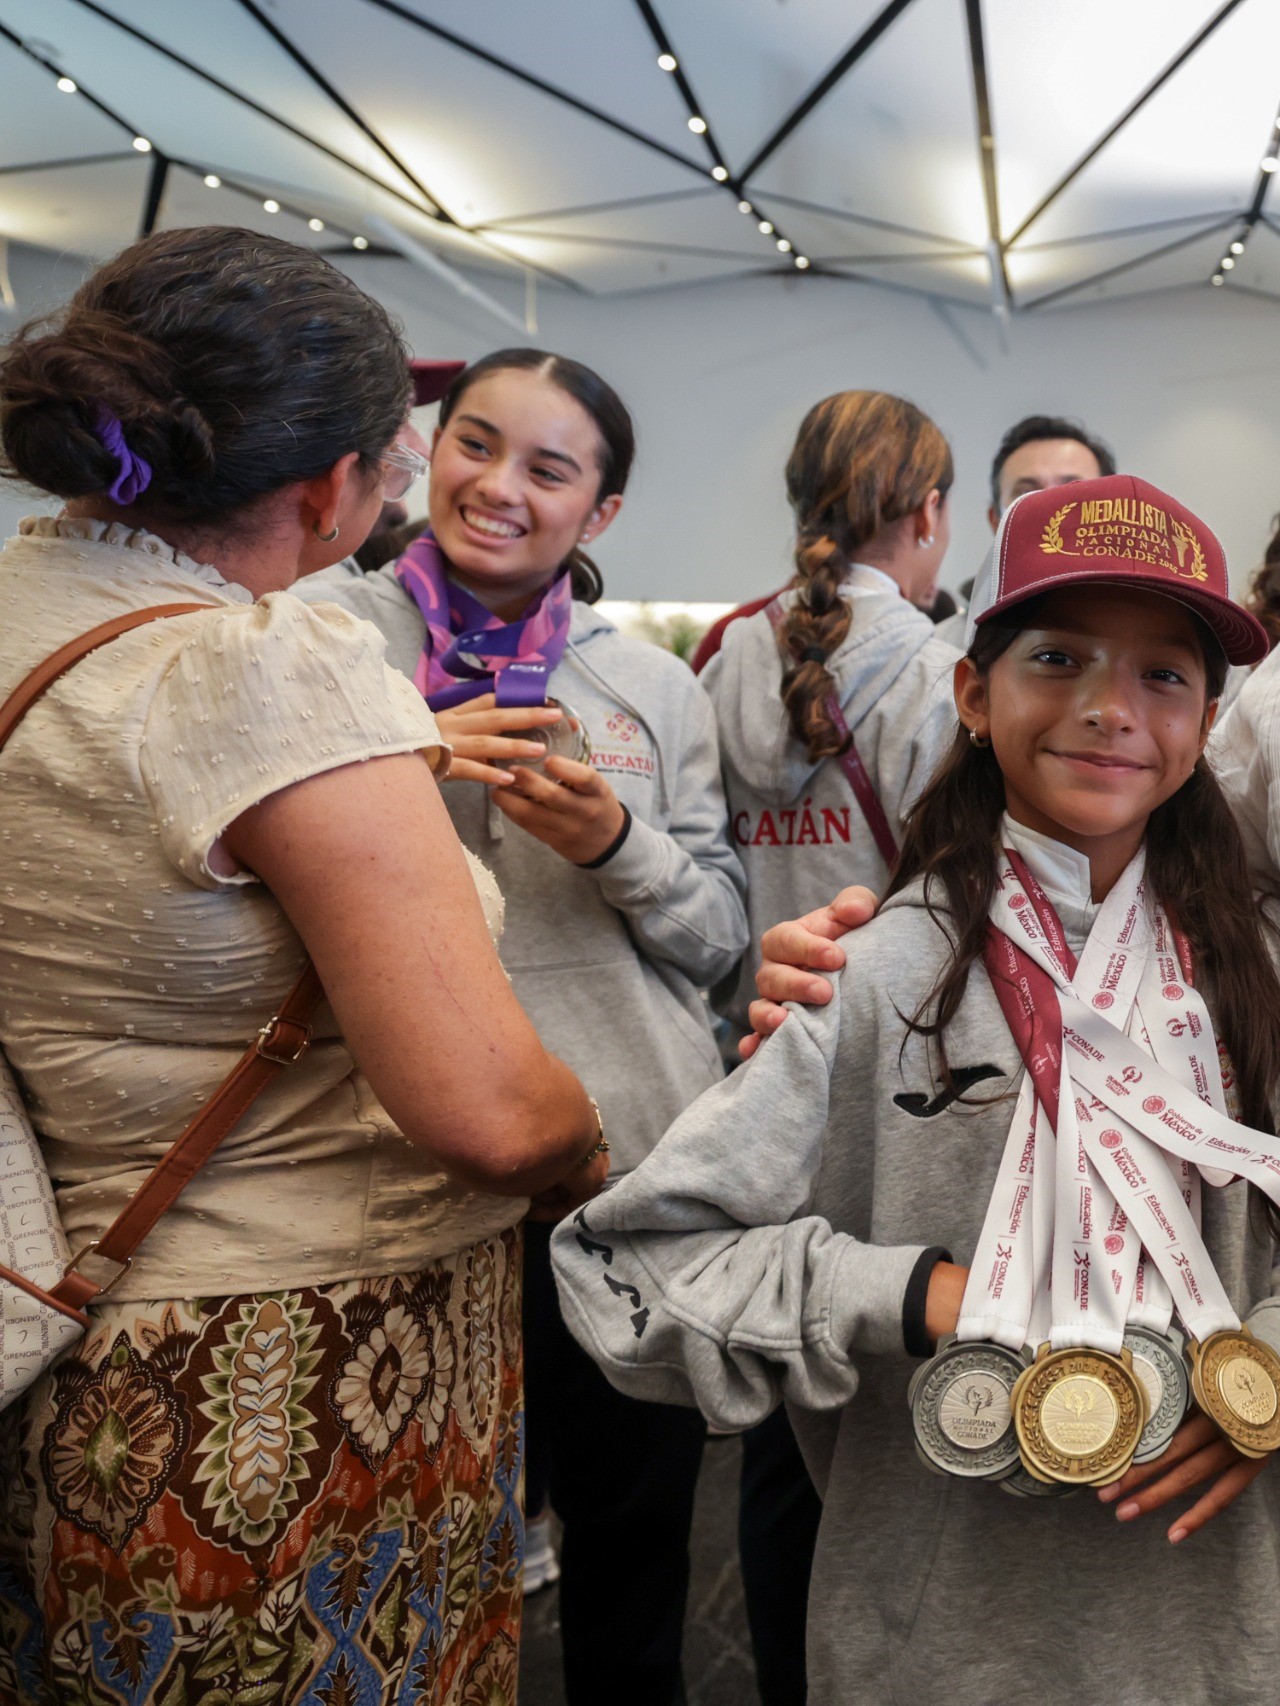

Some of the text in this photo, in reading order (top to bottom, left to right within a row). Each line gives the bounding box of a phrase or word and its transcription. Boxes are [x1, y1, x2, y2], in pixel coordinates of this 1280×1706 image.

[1080, 498, 1168, 537] MEDALLISTA
[1076, 524, 1171, 550] OLIMPIADA
[1076, 536, 1171, 558] NACIONAL
[1083, 546, 1178, 574] CONADE 2025
[733, 796, 850, 846] CATÁN
[1015, 909, 1037, 939] México
[1042, 908, 1062, 951] Educación
[1117, 904, 1138, 944] Educación
[1100, 952, 1117, 989] Gobierno de
[1105, 954, 1127, 991] México
[1166, 957, 1178, 983] México
[1072, 1034, 1105, 1062] CONADE
[1188, 1055, 1204, 1093] CONADE
[1159, 1113, 1197, 1141] México
[1167, 1108, 1203, 1135] Gobierno de
[1208, 1137, 1251, 1156] Educación
[1110, 1150, 1139, 1188] México
[1121, 1147, 1147, 1185] Gobierno de
[6, 1197, 41, 1211] GRENOBIL
[1010, 1185, 1030, 1234] Educación
[1083, 1187, 1093, 1239] Educación
[1147, 1194, 1176, 1241] Educación
[13, 1228, 49, 1241] GRENOBIL
[17, 1260, 54, 1273] GRENOBIL
[992, 1261, 1008, 1300] CONADE
[1080, 1269, 1089, 1311] CONADE
[1136, 1266, 1145, 1303] CONADE
[1185, 1268, 1204, 1306] CONADE
[4, 1349, 42, 1360] GRENOBIL
[1069, 1362, 1099, 1374] 2025
[952, 1418, 996, 1428] OLIMPIADA
[957, 1431, 988, 1440] CONADE
